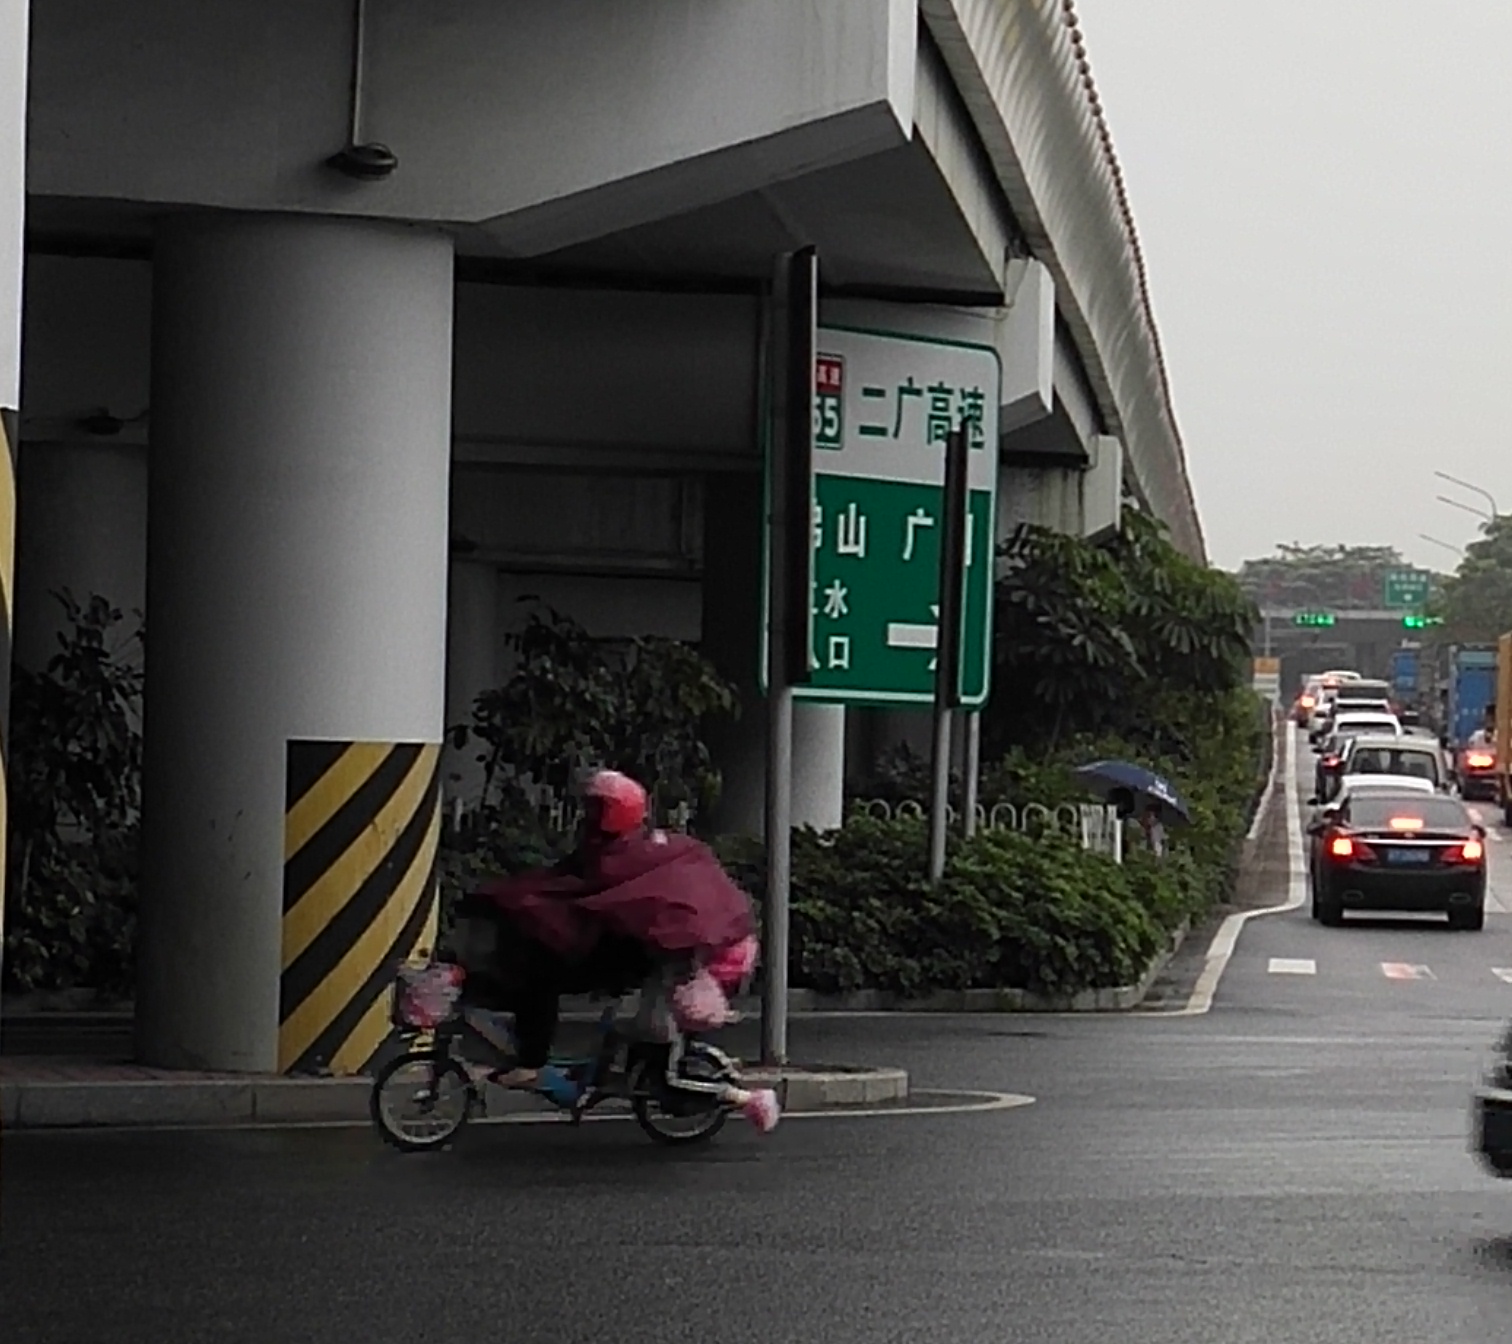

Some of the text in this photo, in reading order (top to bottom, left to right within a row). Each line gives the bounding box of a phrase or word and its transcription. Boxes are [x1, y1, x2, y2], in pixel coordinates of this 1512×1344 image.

[858, 375, 986, 450] 二广高速
[902, 507, 975, 567] 广
[812, 578, 849, 619] 水
